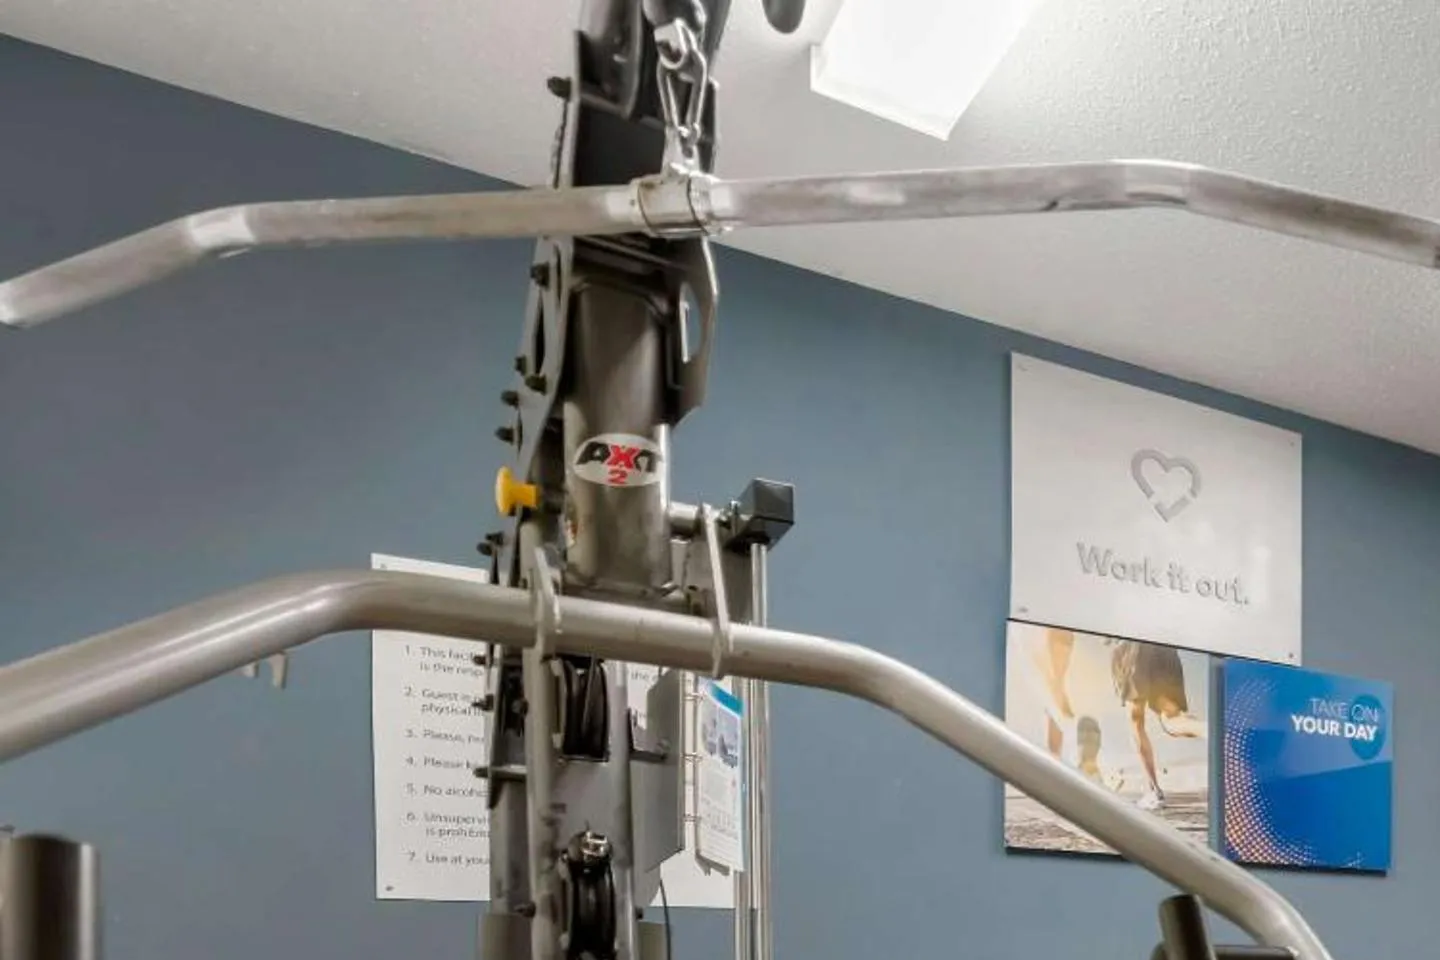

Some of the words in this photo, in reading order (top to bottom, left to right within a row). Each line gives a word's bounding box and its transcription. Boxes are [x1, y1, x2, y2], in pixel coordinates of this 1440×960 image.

[1076, 541, 1162, 588] Work
[1167, 561, 1190, 593] it
[1195, 576, 1251, 605] out.
[420, 646, 447, 659] This
[1309, 698, 1348, 720] TAKE
[1351, 704, 1379, 723] ON
[1291, 714, 1341, 737] YOUR
[1343, 722, 1378, 742] DAY
[423, 756, 463, 770] Please
[423, 784, 442, 796] No
[425, 853, 448, 864] Use
